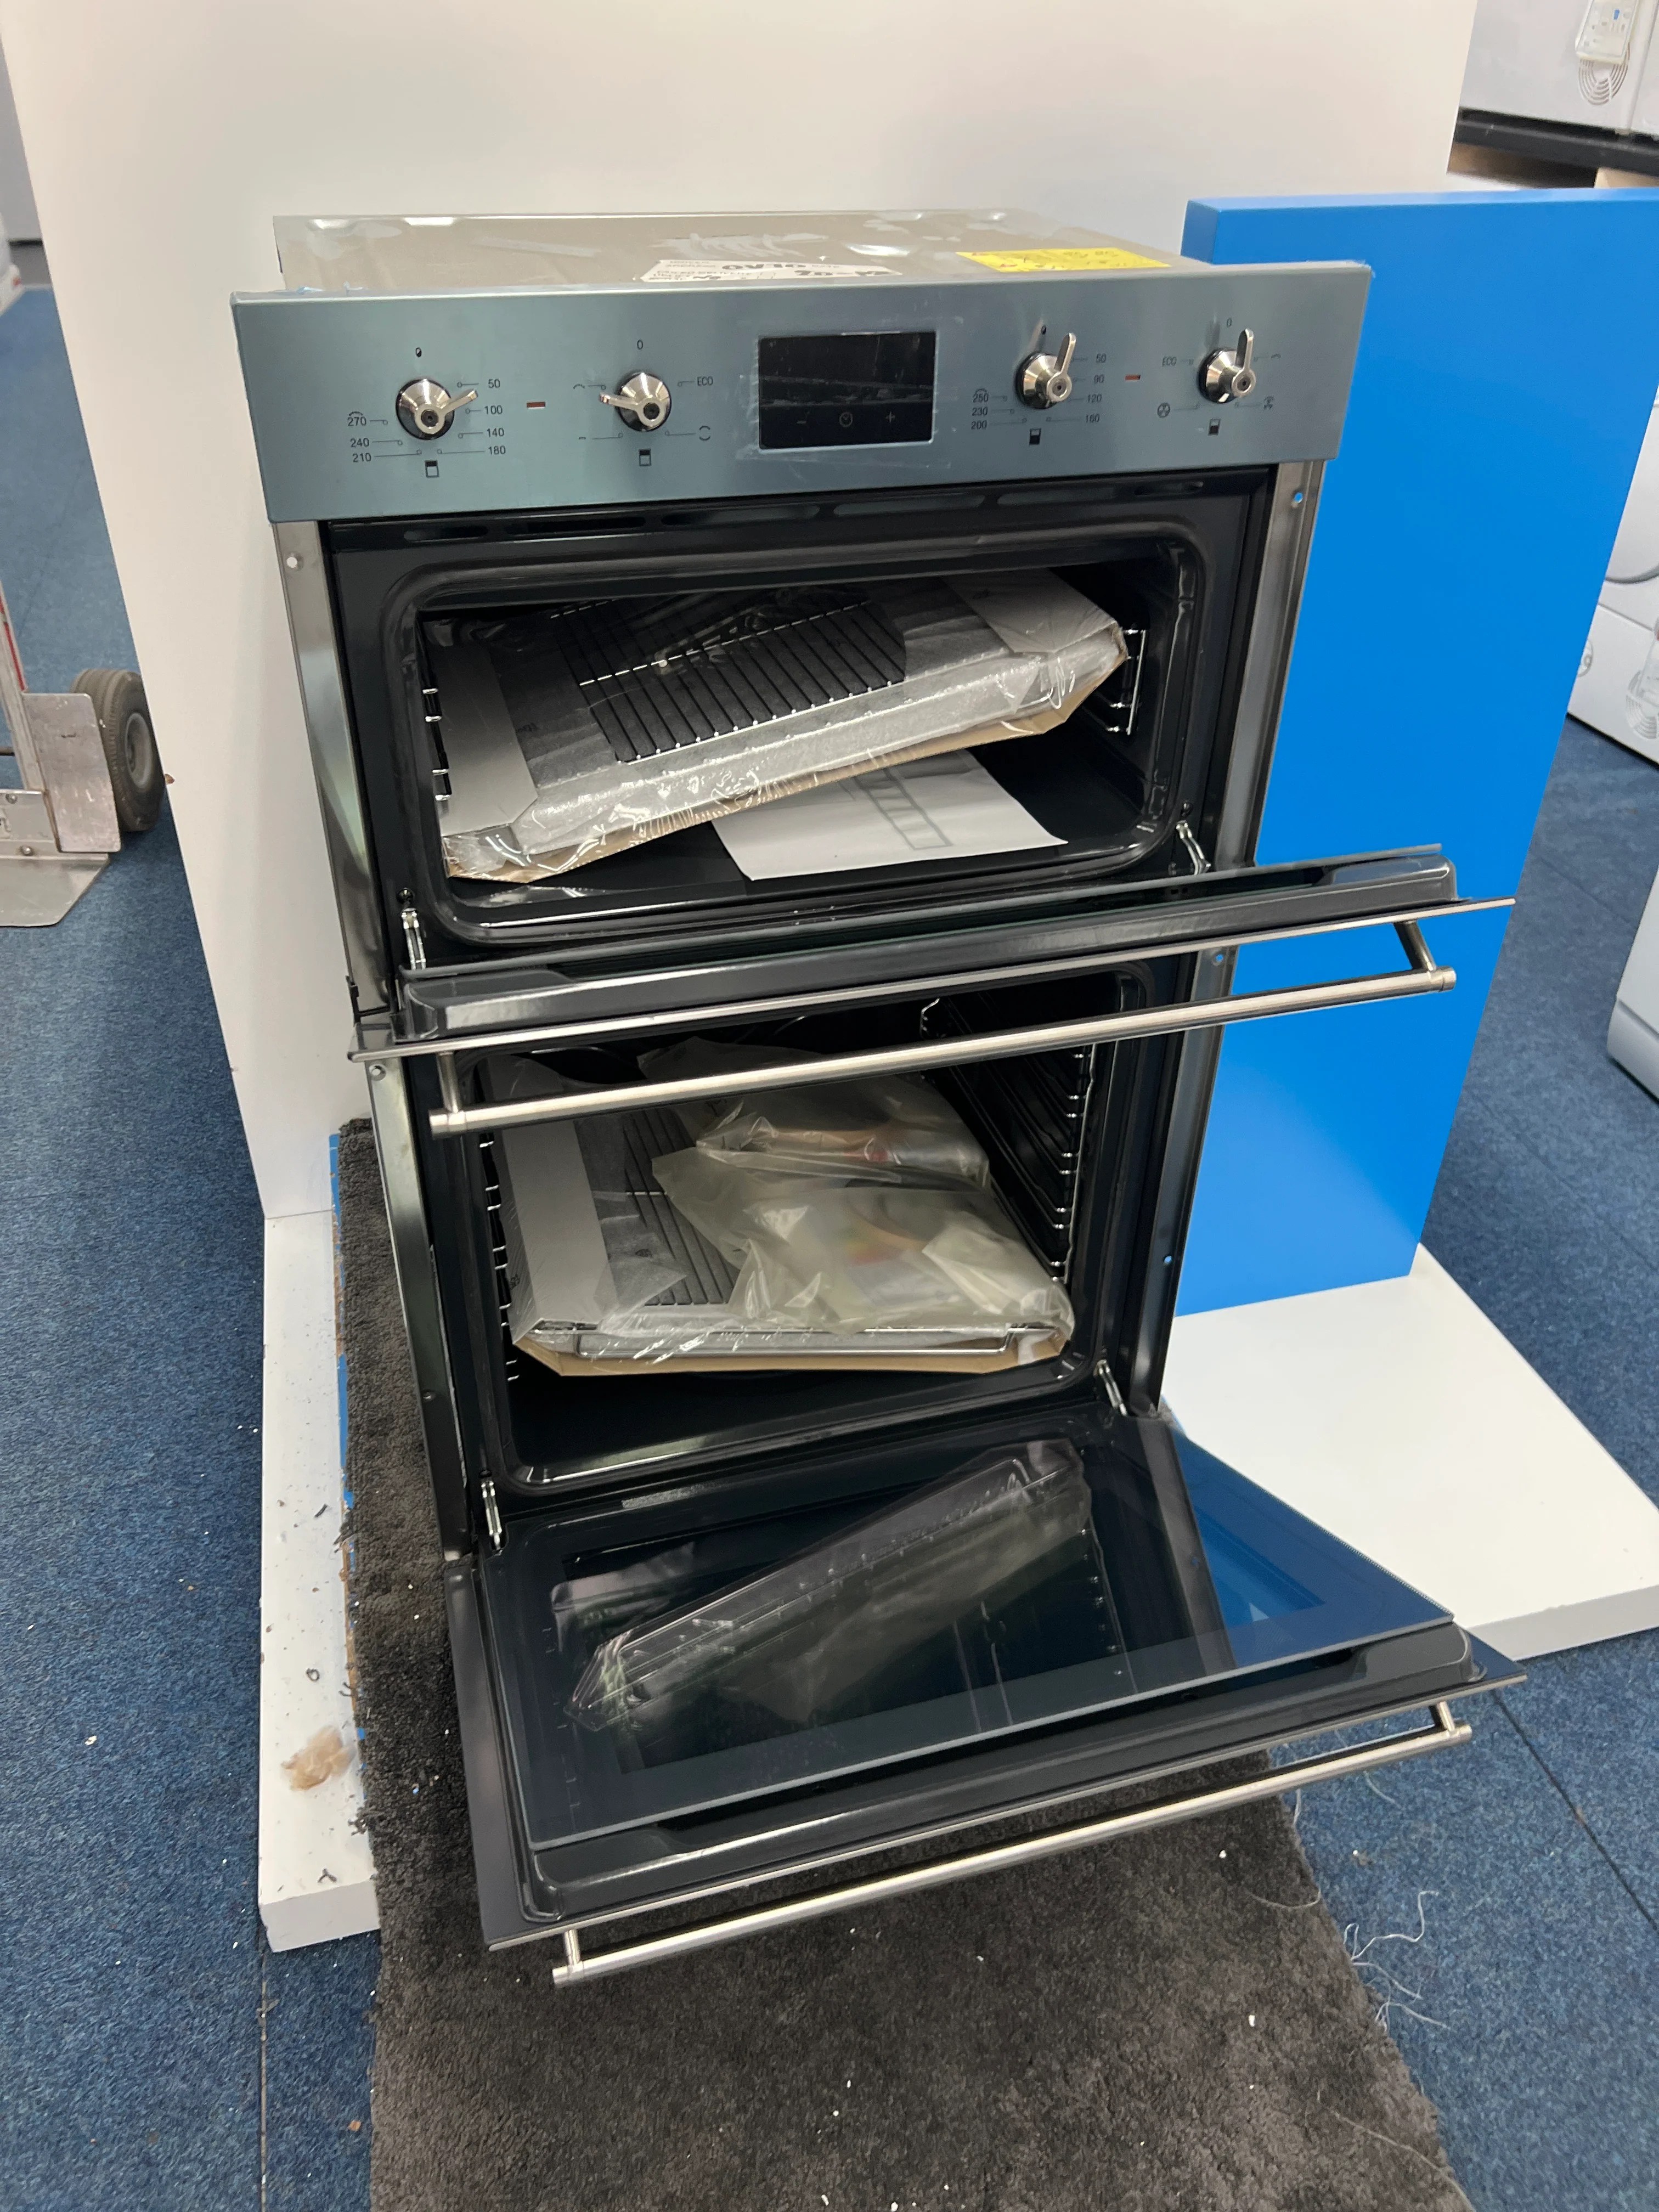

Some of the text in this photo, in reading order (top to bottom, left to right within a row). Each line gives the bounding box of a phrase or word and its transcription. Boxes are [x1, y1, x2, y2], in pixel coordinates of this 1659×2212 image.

[636, 339, 644, 350] 0
[1161, 357, 1177, 367] ECO
[488, 379, 501, 388] 50
[697, 376, 713, 386] ECO
[972, 393, 989, 403] 250
[1087, 393, 1102, 403] 120
[484, 405, 503, 415] 100
[972, 407, 988, 417] 230
[347, 416, 367, 427] 270
[1085, 413, 1100, 423] 160
[971, 420, 988, 430] 200
[486, 427, 504, 438] 140
[350, 438, 370, 448] 240
[488, 445, 506, 455] 180
[352, 453, 371, 462] 210
